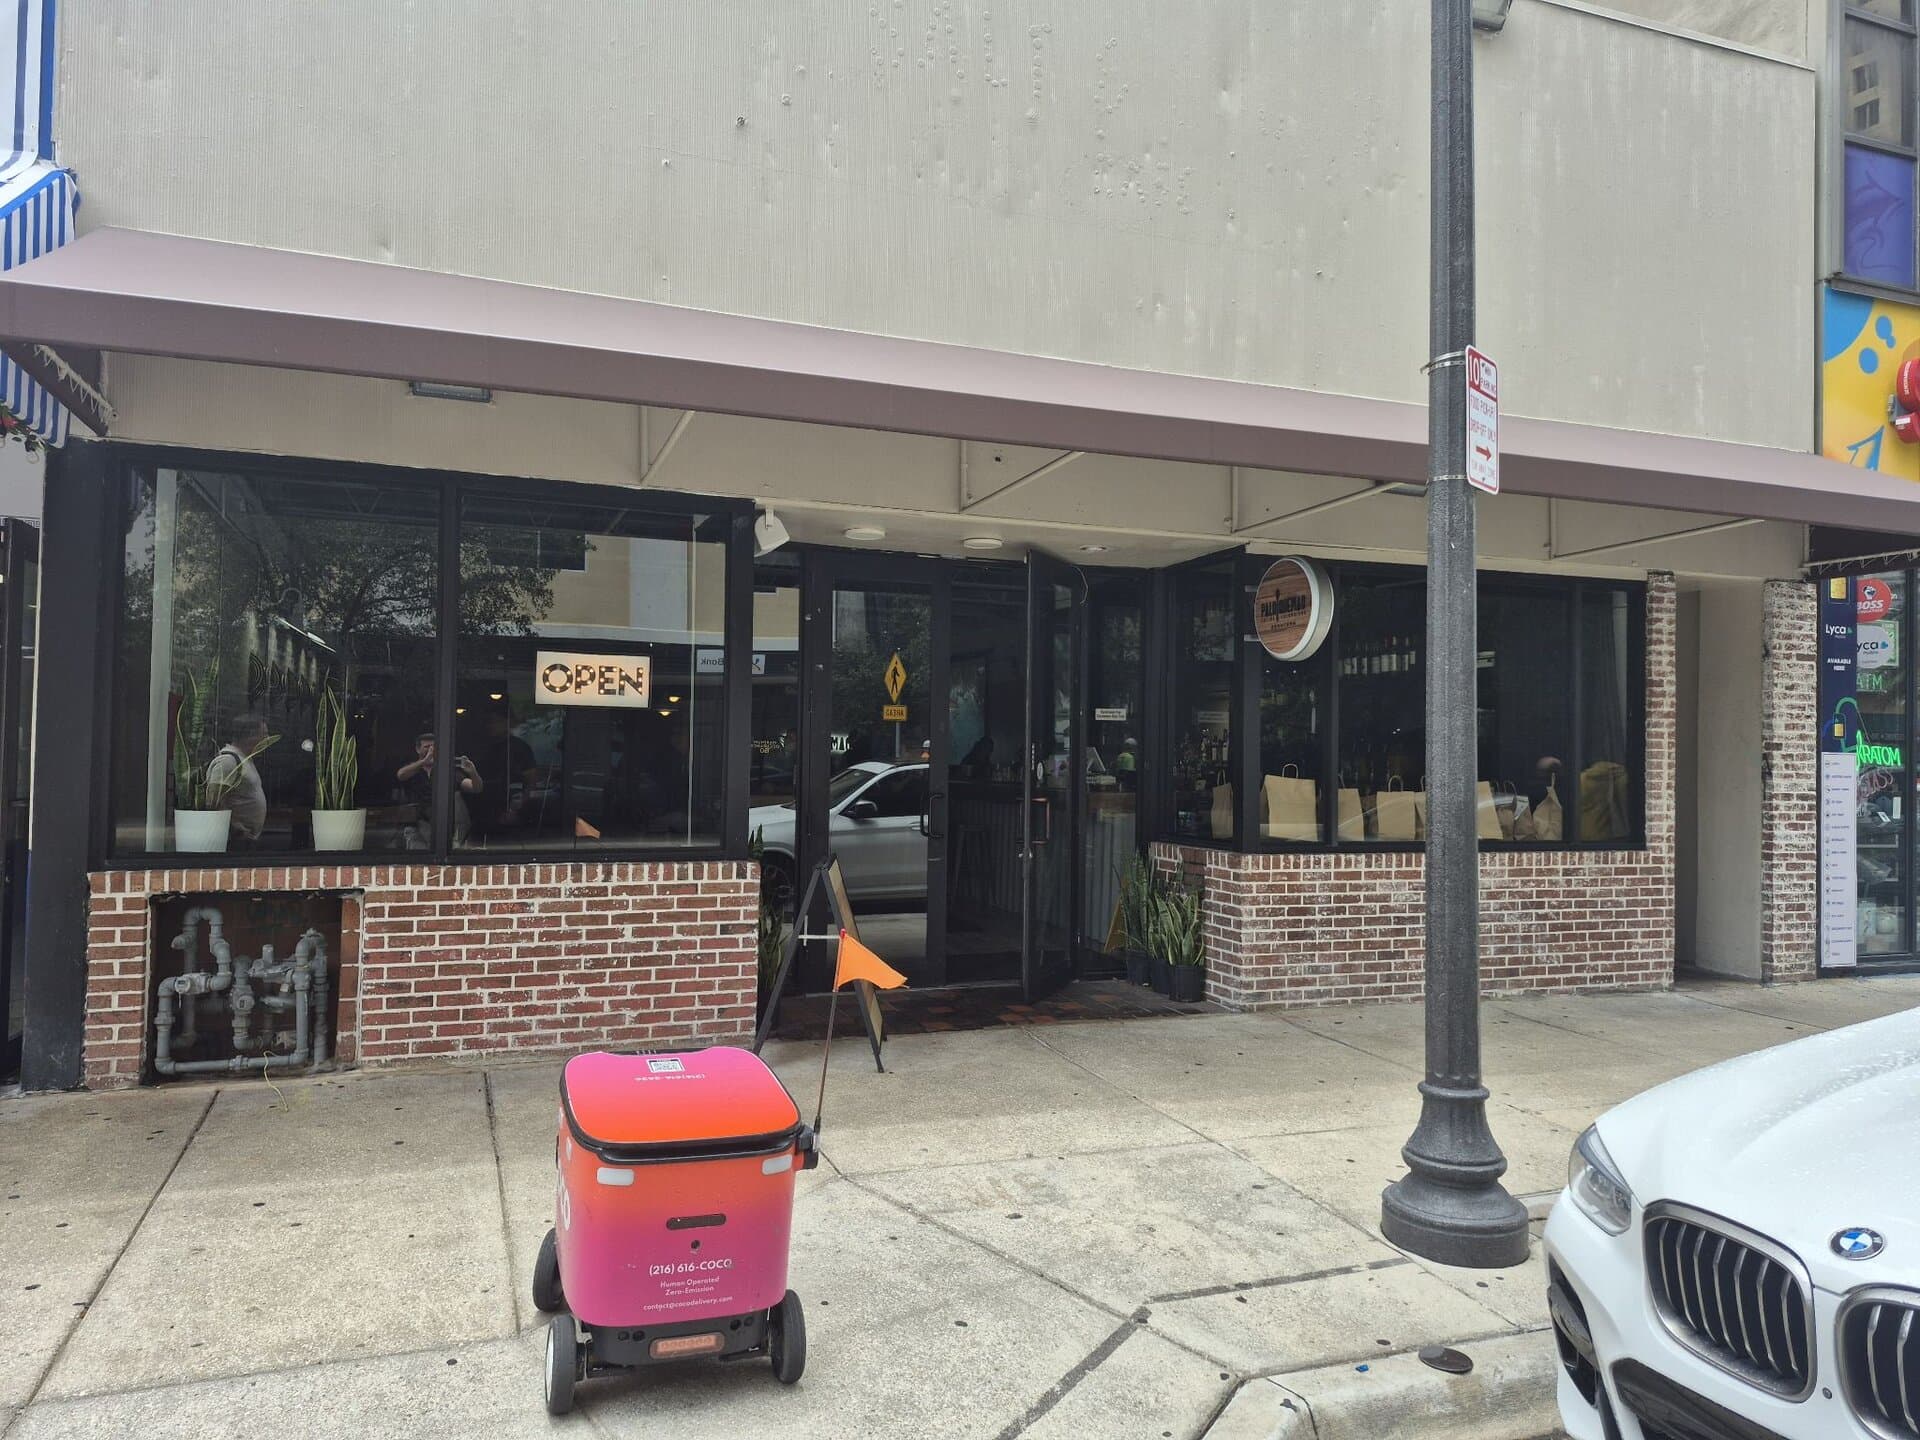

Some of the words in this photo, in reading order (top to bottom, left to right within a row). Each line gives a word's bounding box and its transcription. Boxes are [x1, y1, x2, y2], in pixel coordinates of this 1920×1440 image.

[1469, 354, 1480, 386] 10
[1825, 623, 1847, 636] Lyca
[1857, 641, 1879, 652] yca
[542, 663, 644, 696] OPEN
[1856, 729, 1901, 773] KRATOM
[649, 1263, 675, 1277] (216)
[677, 1259, 733, 1273] 616-COCO
[660, 1280, 685, 1288] Human
[686, 1276, 720, 1287] Operated
[665, 1286, 714, 1296] Zero-Emission
